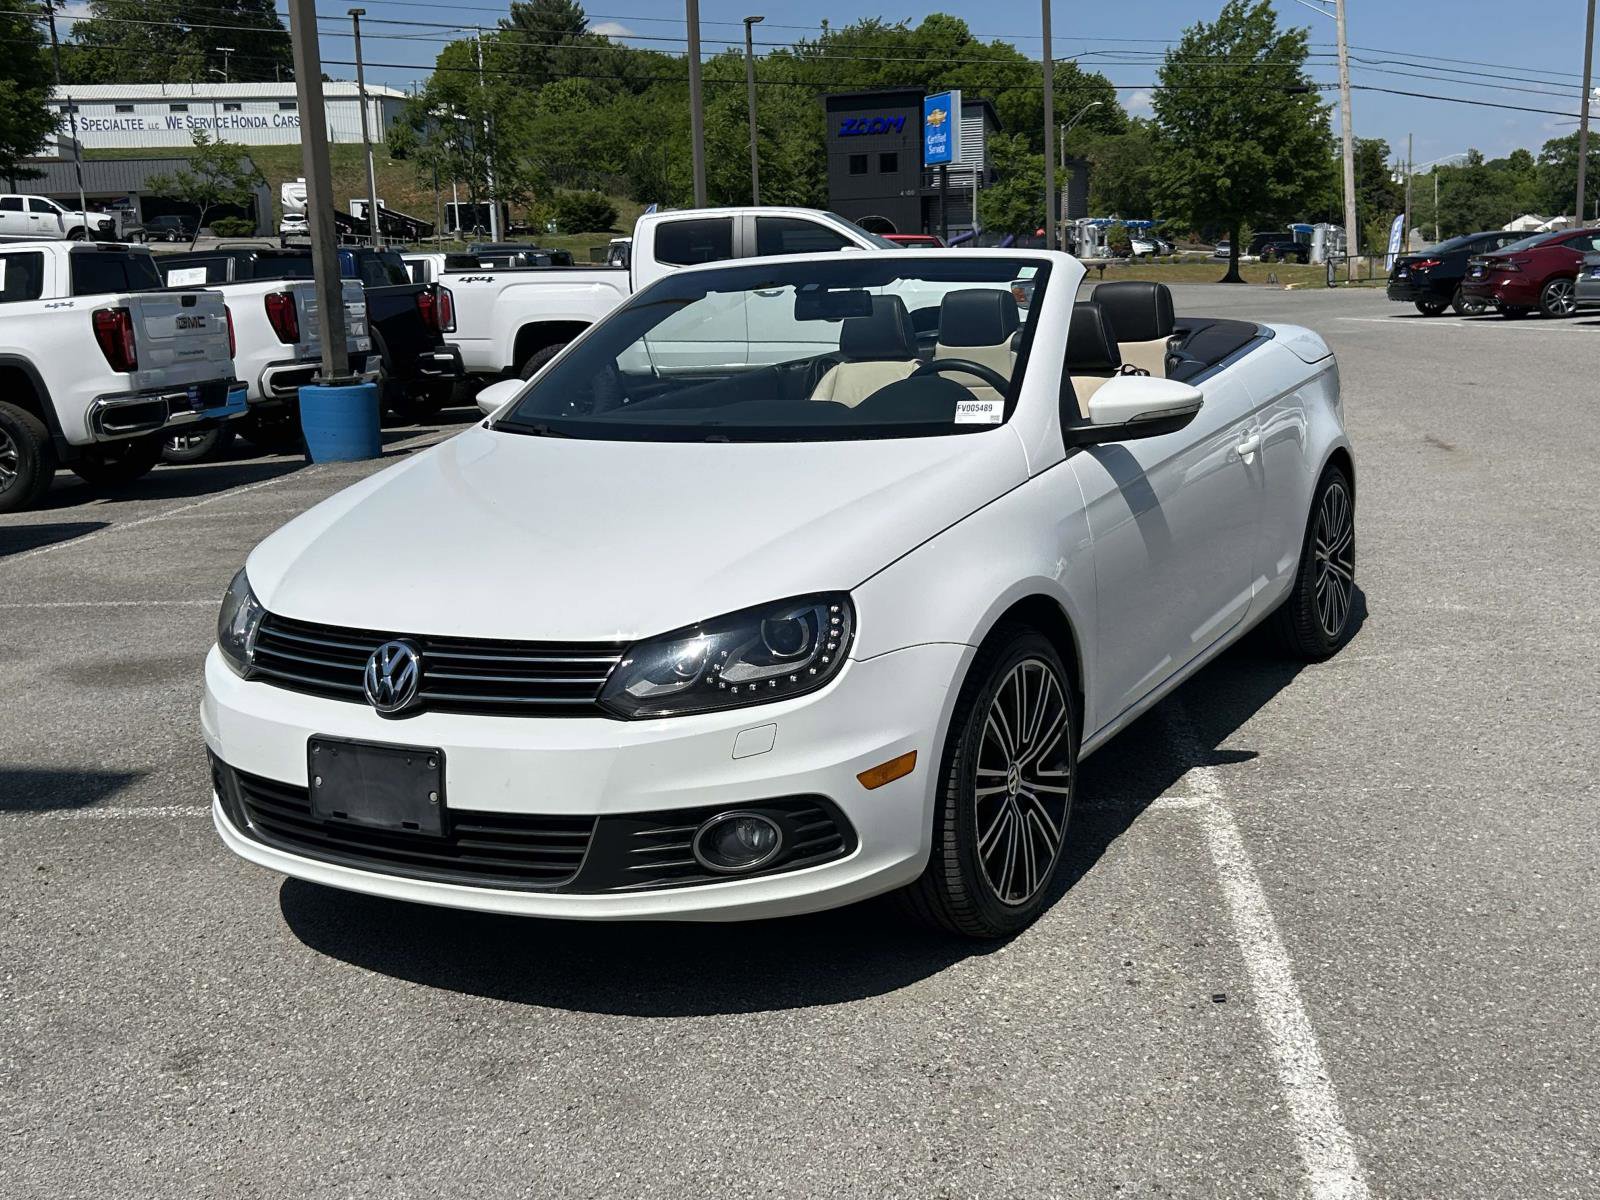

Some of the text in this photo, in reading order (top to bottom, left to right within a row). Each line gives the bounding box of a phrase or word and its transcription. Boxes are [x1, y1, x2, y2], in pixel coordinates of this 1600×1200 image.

[80, 117, 144, 130] SPECIALTEE
[165, 115, 183, 129] WE
[186, 115, 230, 129] SERVICE
[231, 114, 268, 128] HONDA
[273, 113, 301, 127] CARS
[839, 115, 906, 138] ZOOM
[927, 132, 947, 145] Certified
[928, 145, 945, 154] Service
[175, 315, 206, 330] GMC
[956, 403, 993, 412] FV005489
